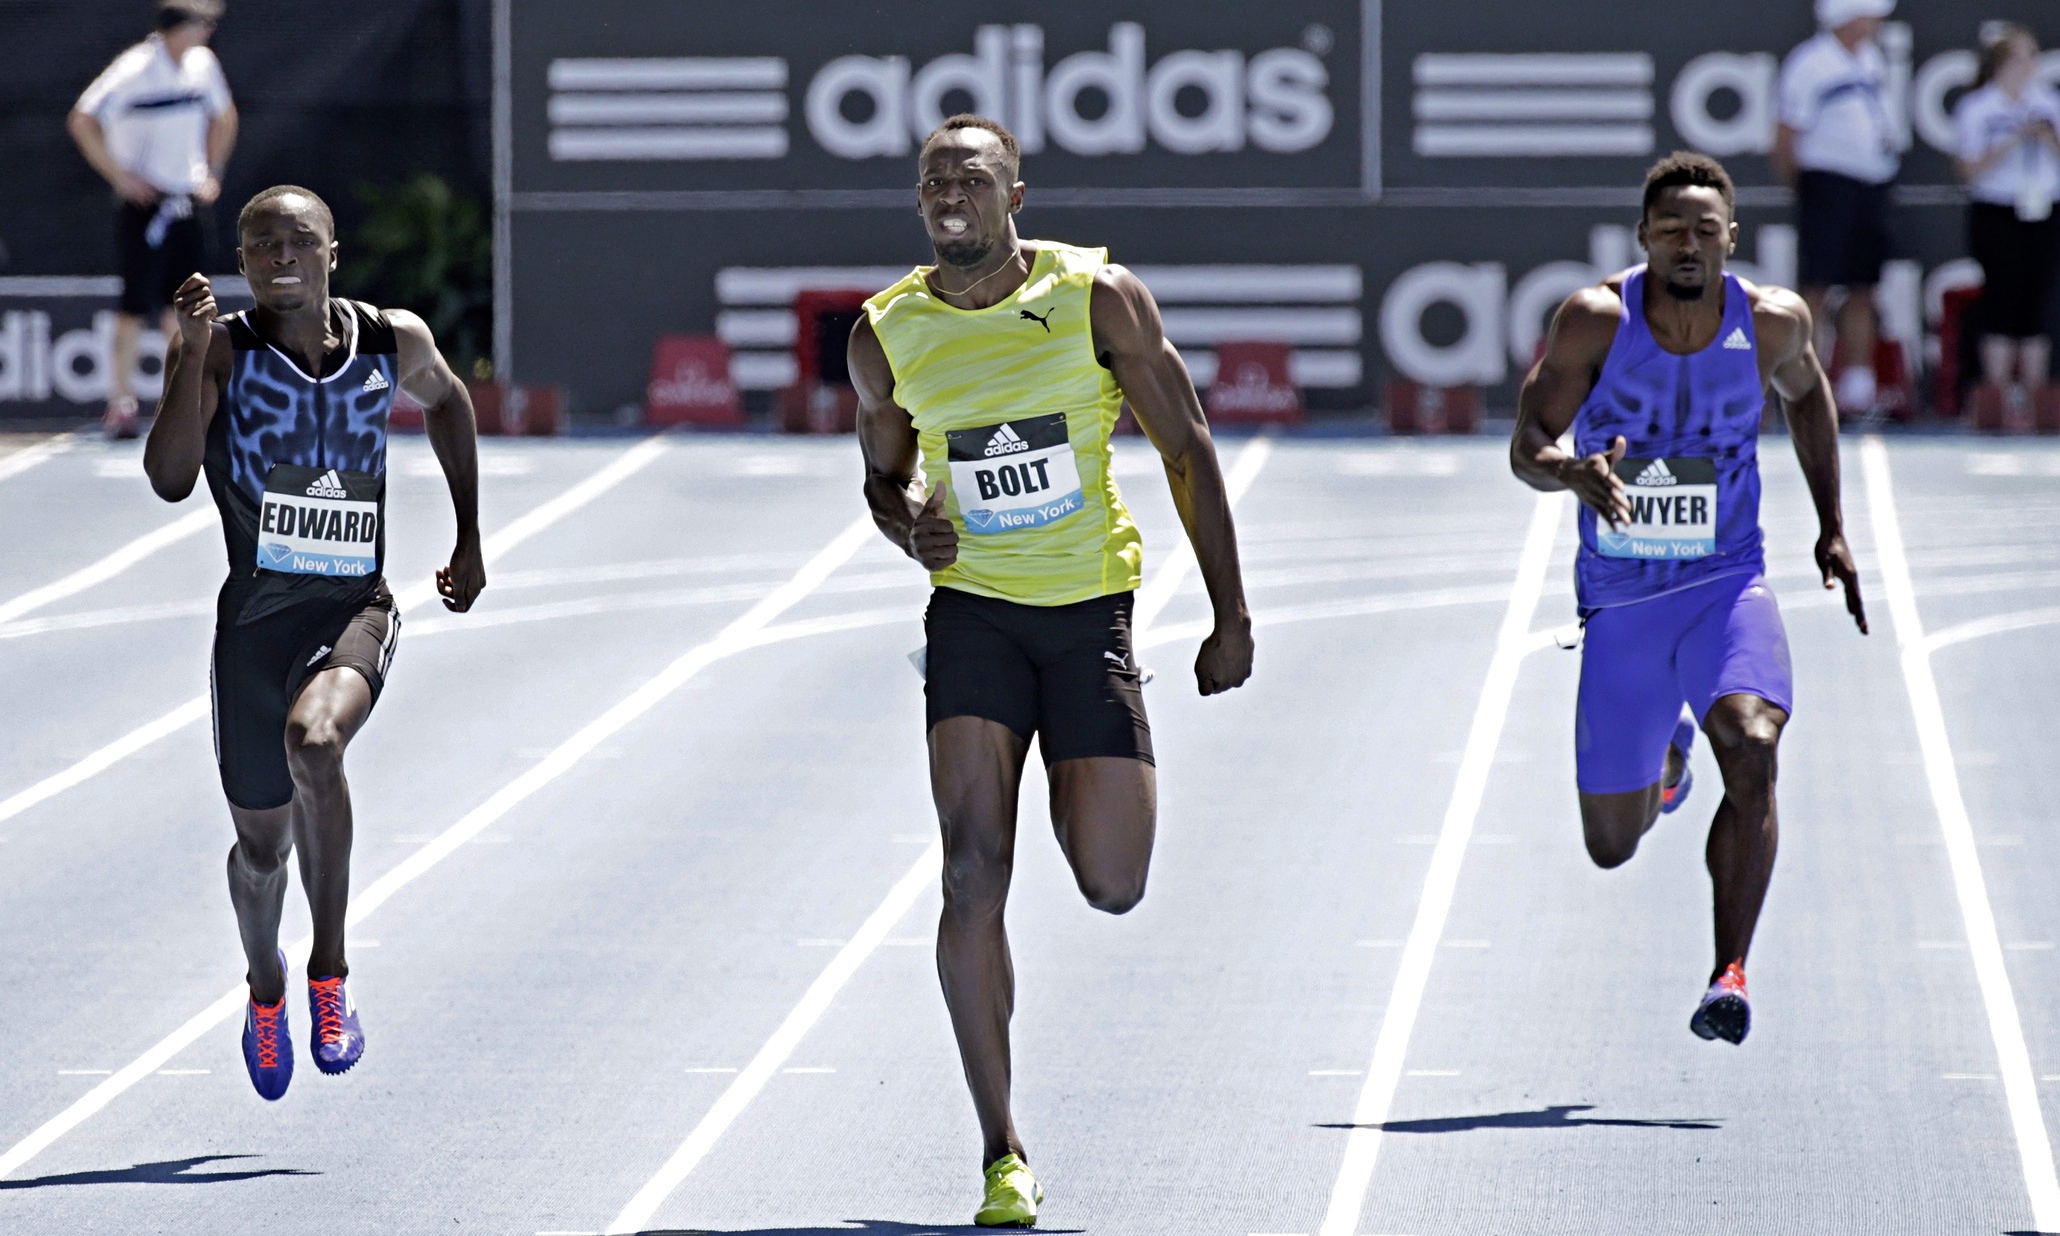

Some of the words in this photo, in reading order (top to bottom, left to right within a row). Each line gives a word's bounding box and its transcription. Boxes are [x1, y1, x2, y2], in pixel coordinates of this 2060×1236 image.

[804, 21, 1335, 159] adidas
[984, 440, 1029, 457] adidas
[974, 457, 1050, 501] BOLT
[1635, 475, 1678, 486] adidas
[305, 486, 347, 499] adidas
[261, 501, 377, 543] EDWARD
[999, 513, 1035, 528] New
[1038, 498, 1075, 521] York
[1614, 495, 1708, 525] WYER
[1632, 541, 1666, 556] New
[1671, 542, 1706, 556] York
[293, 555, 329, 573] New
[332, 559, 366, 575] York
